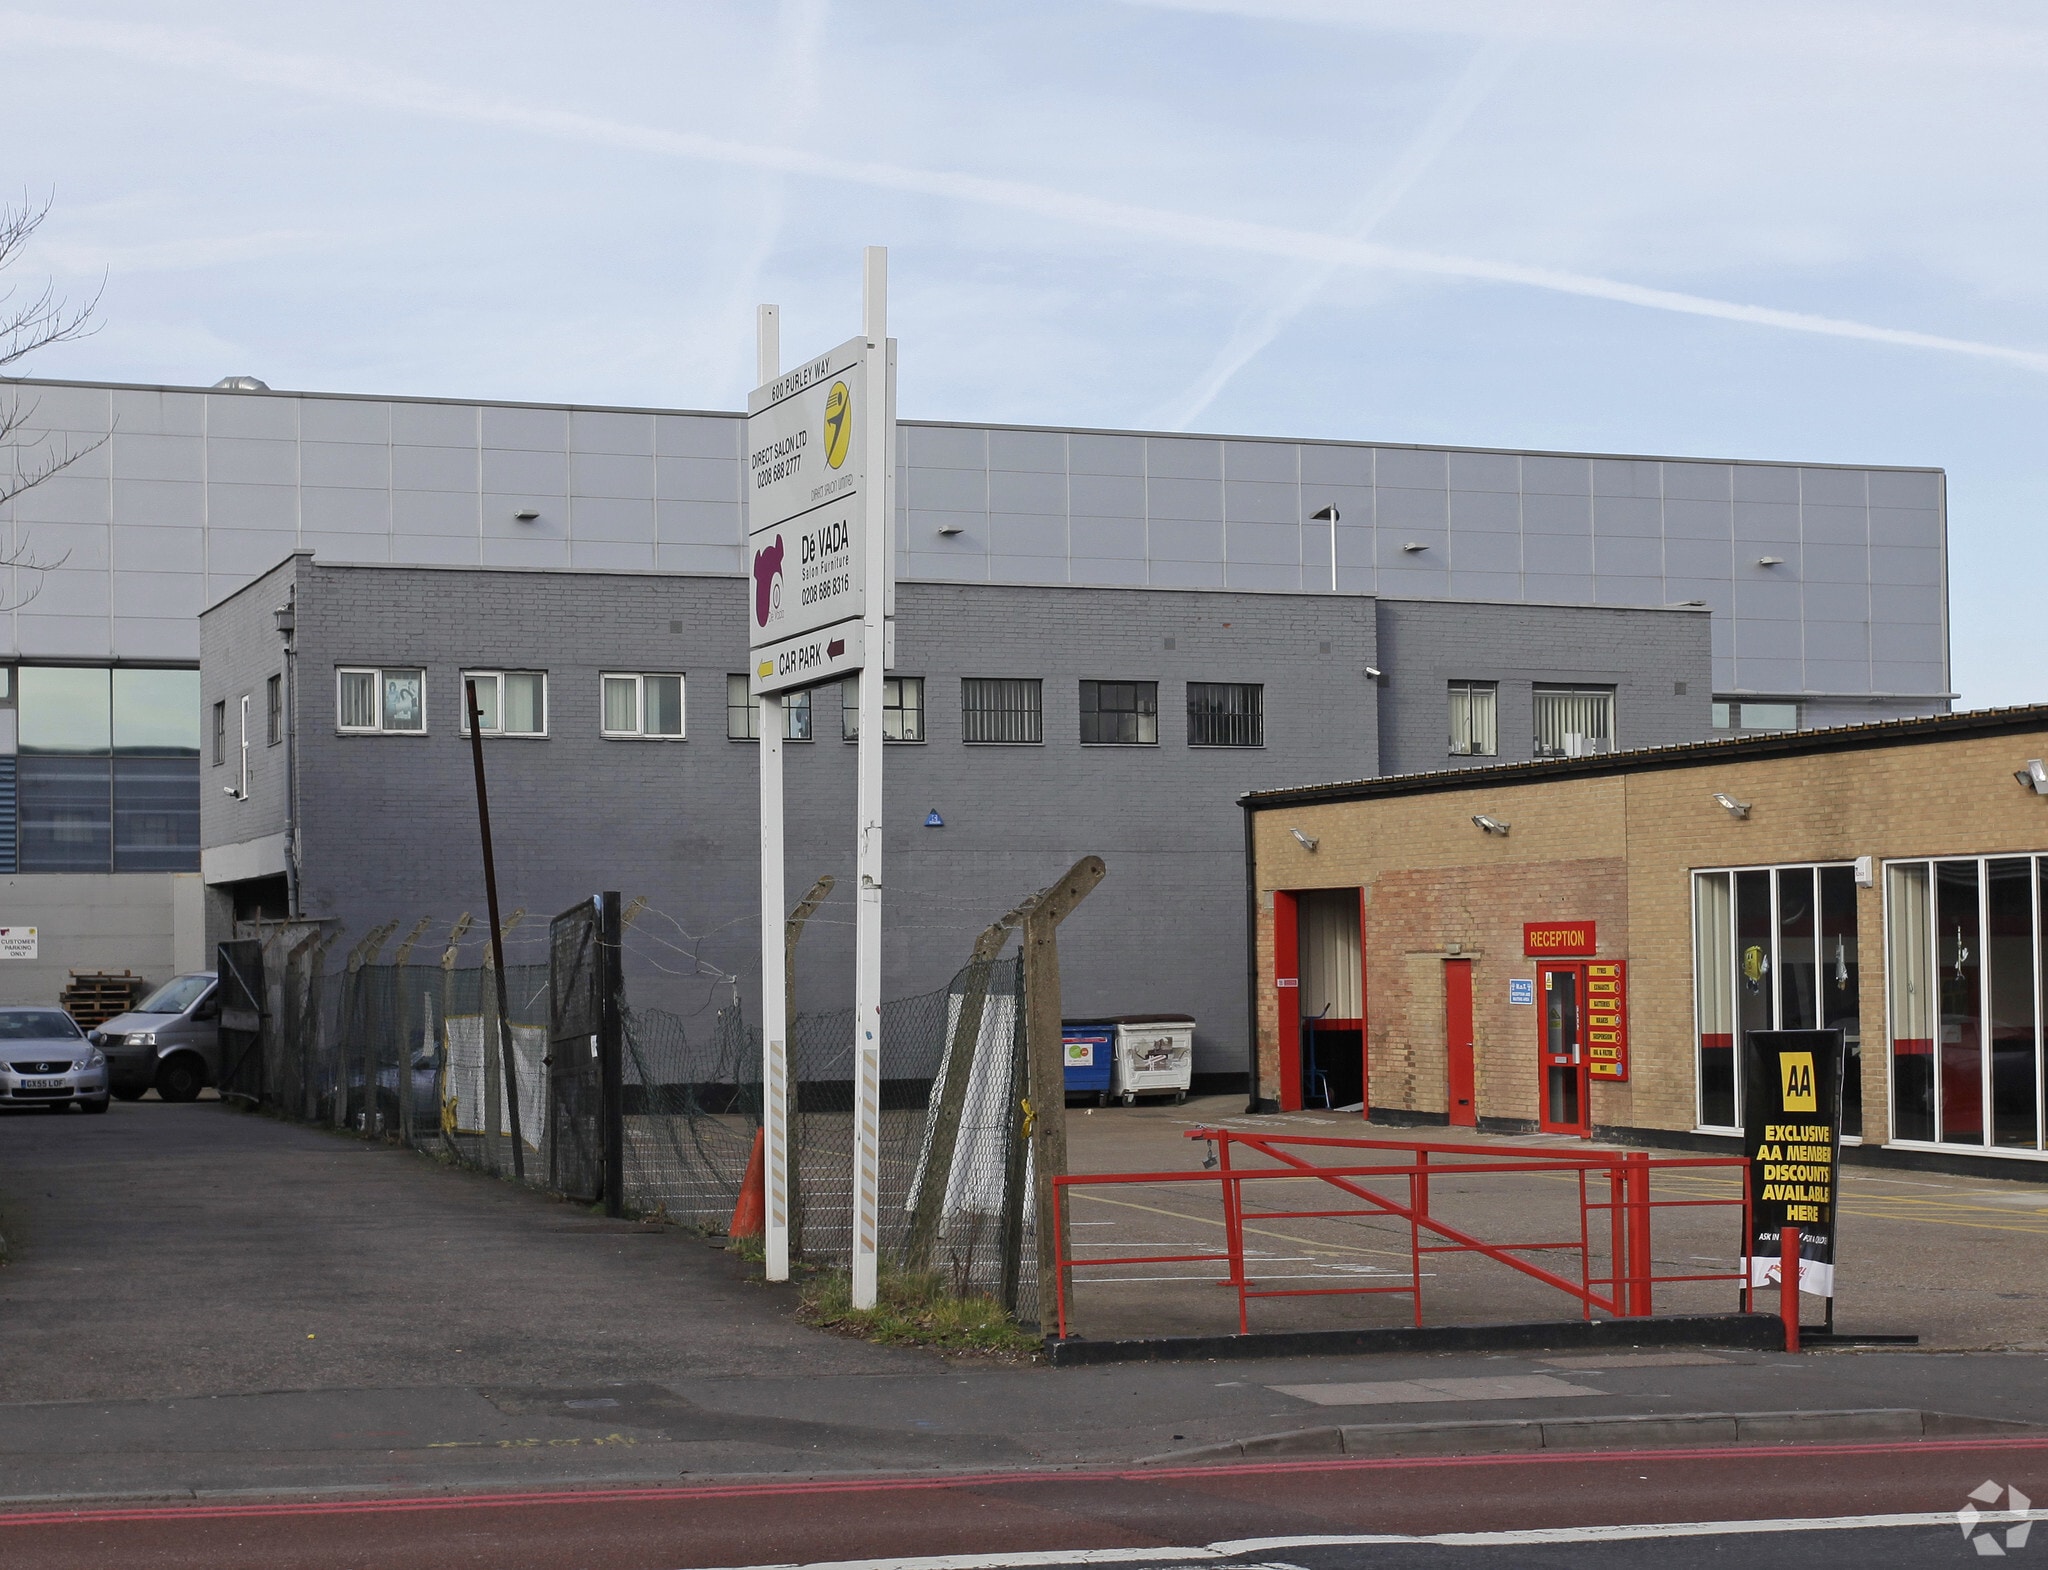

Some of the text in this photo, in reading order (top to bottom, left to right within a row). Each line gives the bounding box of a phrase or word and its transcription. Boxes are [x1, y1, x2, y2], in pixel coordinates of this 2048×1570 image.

[772, 357, 830, 401] 600 PURLEY WAY
[751, 430, 807, 470] DIRECT SALON LTD
[757, 454, 801, 489] 0208 688 2777
[802, 519, 849, 565] Dé VADA
[802, 554, 849, 582] Salon Furniture
[802, 573, 849, 606] 0208 686 8316
[779, 642, 822, 676] CAR PARK
[1530, 930, 1585, 947] RECEPTION
[1786, 1065, 1811, 1097] AA
[1765, 1125, 1831, 1143] EXCLUSIVE
[1756, 1144, 1832, 1163] AA MEMBER
[1764, 1164, 1830, 1183] DISCOUNTS
[1761, 1184, 1830, 1203] AVAILABLE
[1786, 1204, 1819, 1222] HERE
[1758, 1232, 1771, 1241] ASK
[1771, 1233, 1780, 1241] IN
